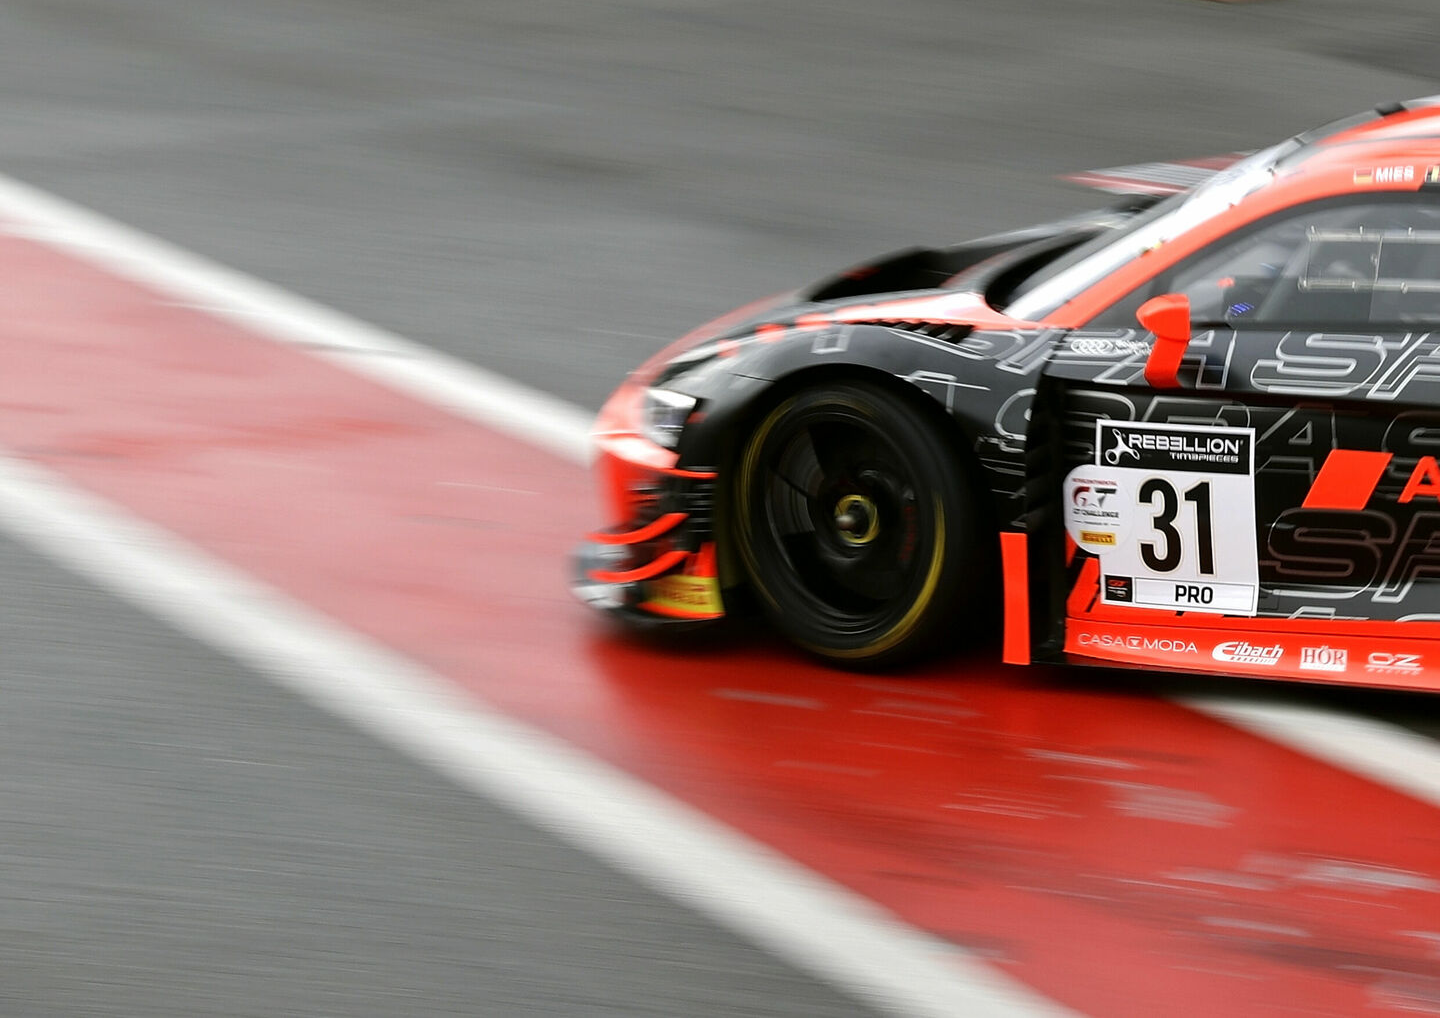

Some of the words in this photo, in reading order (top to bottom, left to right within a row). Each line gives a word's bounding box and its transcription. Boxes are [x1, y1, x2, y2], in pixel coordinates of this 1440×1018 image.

[1128, 433, 1240, 455] REBELLION
[1138, 476, 1215, 576] 31
[1174, 584, 1214, 604] PRO
[1077, 632, 1126, 647] CASA
[1142, 637, 1199, 654] MODA
[1211, 641, 1284, 664] Eibach
